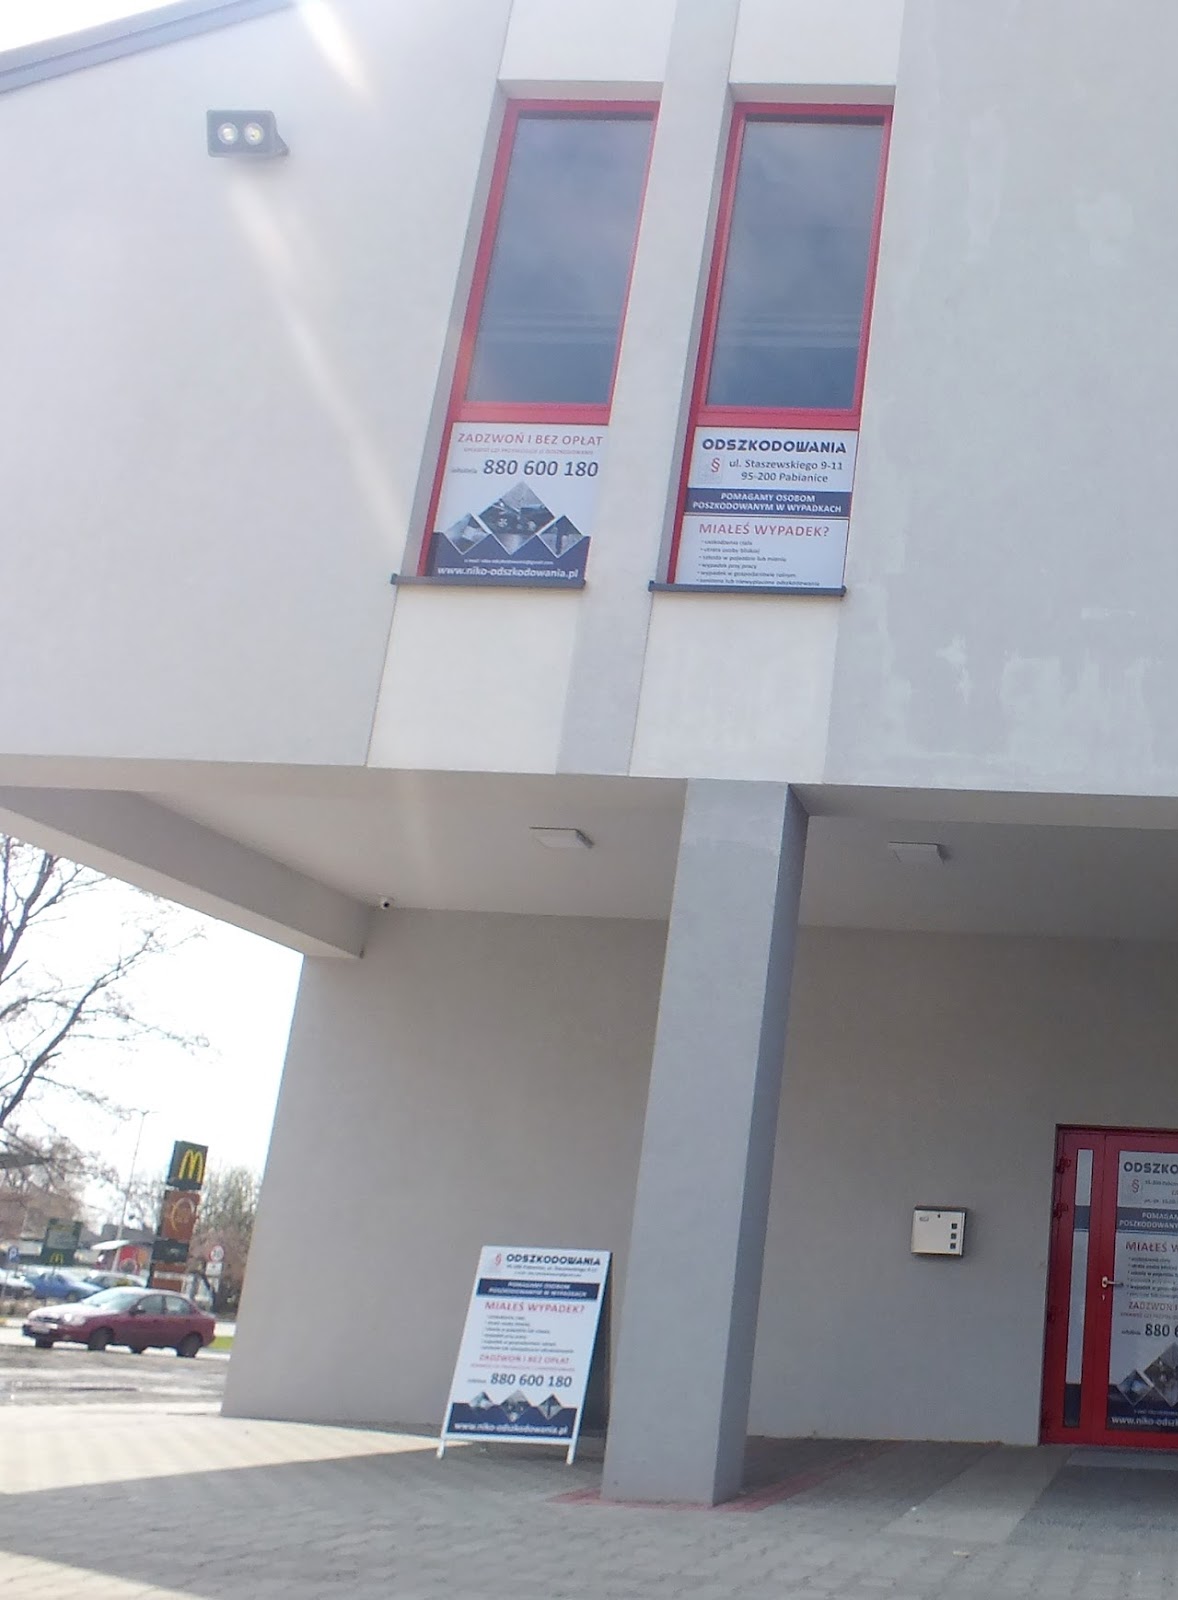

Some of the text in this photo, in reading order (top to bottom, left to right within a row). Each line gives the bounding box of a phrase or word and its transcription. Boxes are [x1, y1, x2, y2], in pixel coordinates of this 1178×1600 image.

[458, 432, 524, 444] ZADZWOŃ
[535, 435, 559, 445] BEZ
[562, 435, 604, 446] OPŁAT
[702, 438, 847, 454] ODSZKODOWANIA
[483, 459, 599, 477] 880 600 180
[729, 459, 843, 471] ul. Staszewskiego 9-11
[741, 472, 829, 483] 95-200 Pabianice
[721, 492, 816, 503] POMAGAMY OSOBOM
[693, 501, 774, 512] POSZKODOWANYM
[787, 504, 842, 513] WYPADKACH
[699, 522, 830, 537] MIAŁEŚ WYPADEK?
[437, 565, 579, 580] www.niko-odszkodowania.pl
[1125, 1241, 1168, 1253] MIAŁEŚ
[506, 1254, 601, 1266] ODSZKODOWANIA
[485, 1300, 585, 1313] MIAŁEŚ WYPADEK?
[1145, 1323, 1170, 1336] 880
[490, 1373, 573, 1388] 880 600 180
